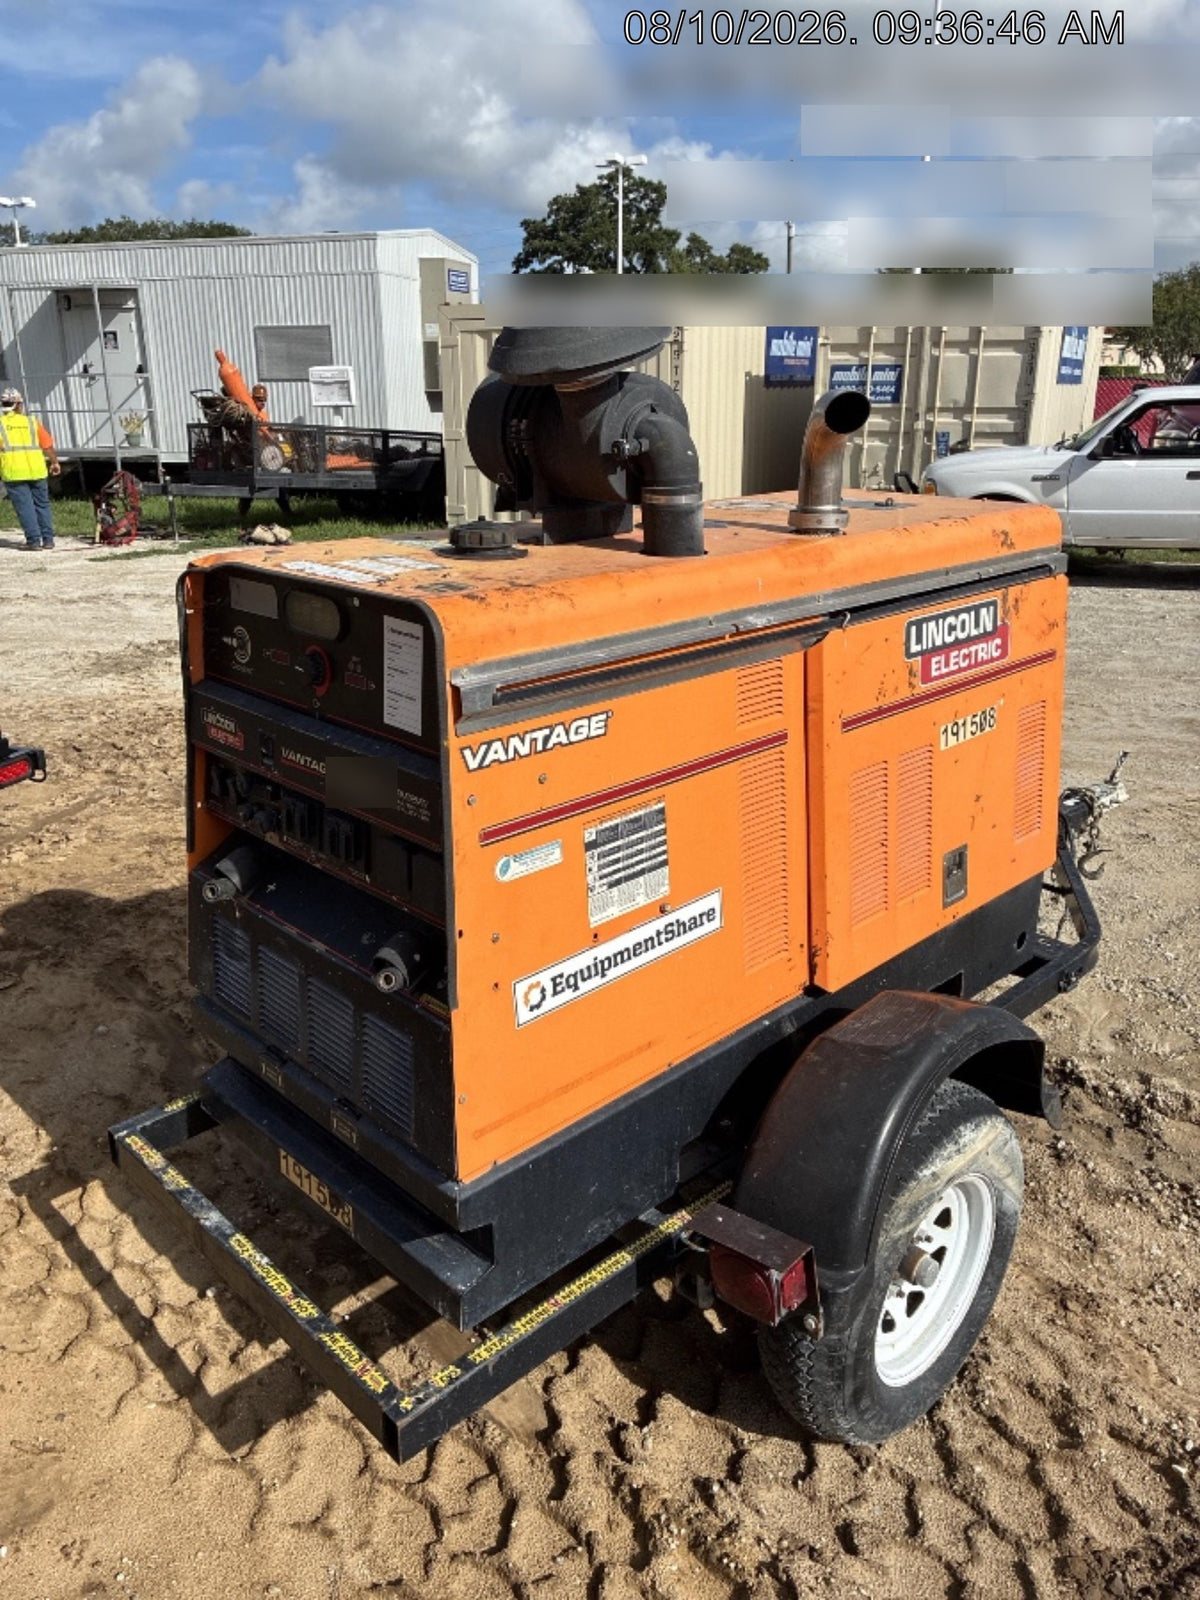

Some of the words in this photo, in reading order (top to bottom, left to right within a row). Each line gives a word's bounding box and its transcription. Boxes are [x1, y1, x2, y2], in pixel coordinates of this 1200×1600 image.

[909, 605, 995, 653] LINCOLN
[931, 637, 1002, 678] ELECTRIC
[461, 711, 609, 772] VANTAGE
[942, 706, 997, 747] 191508
[281, 747, 326, 774] VANTAG
[550, 906, 717, 998] EquipmentShare
